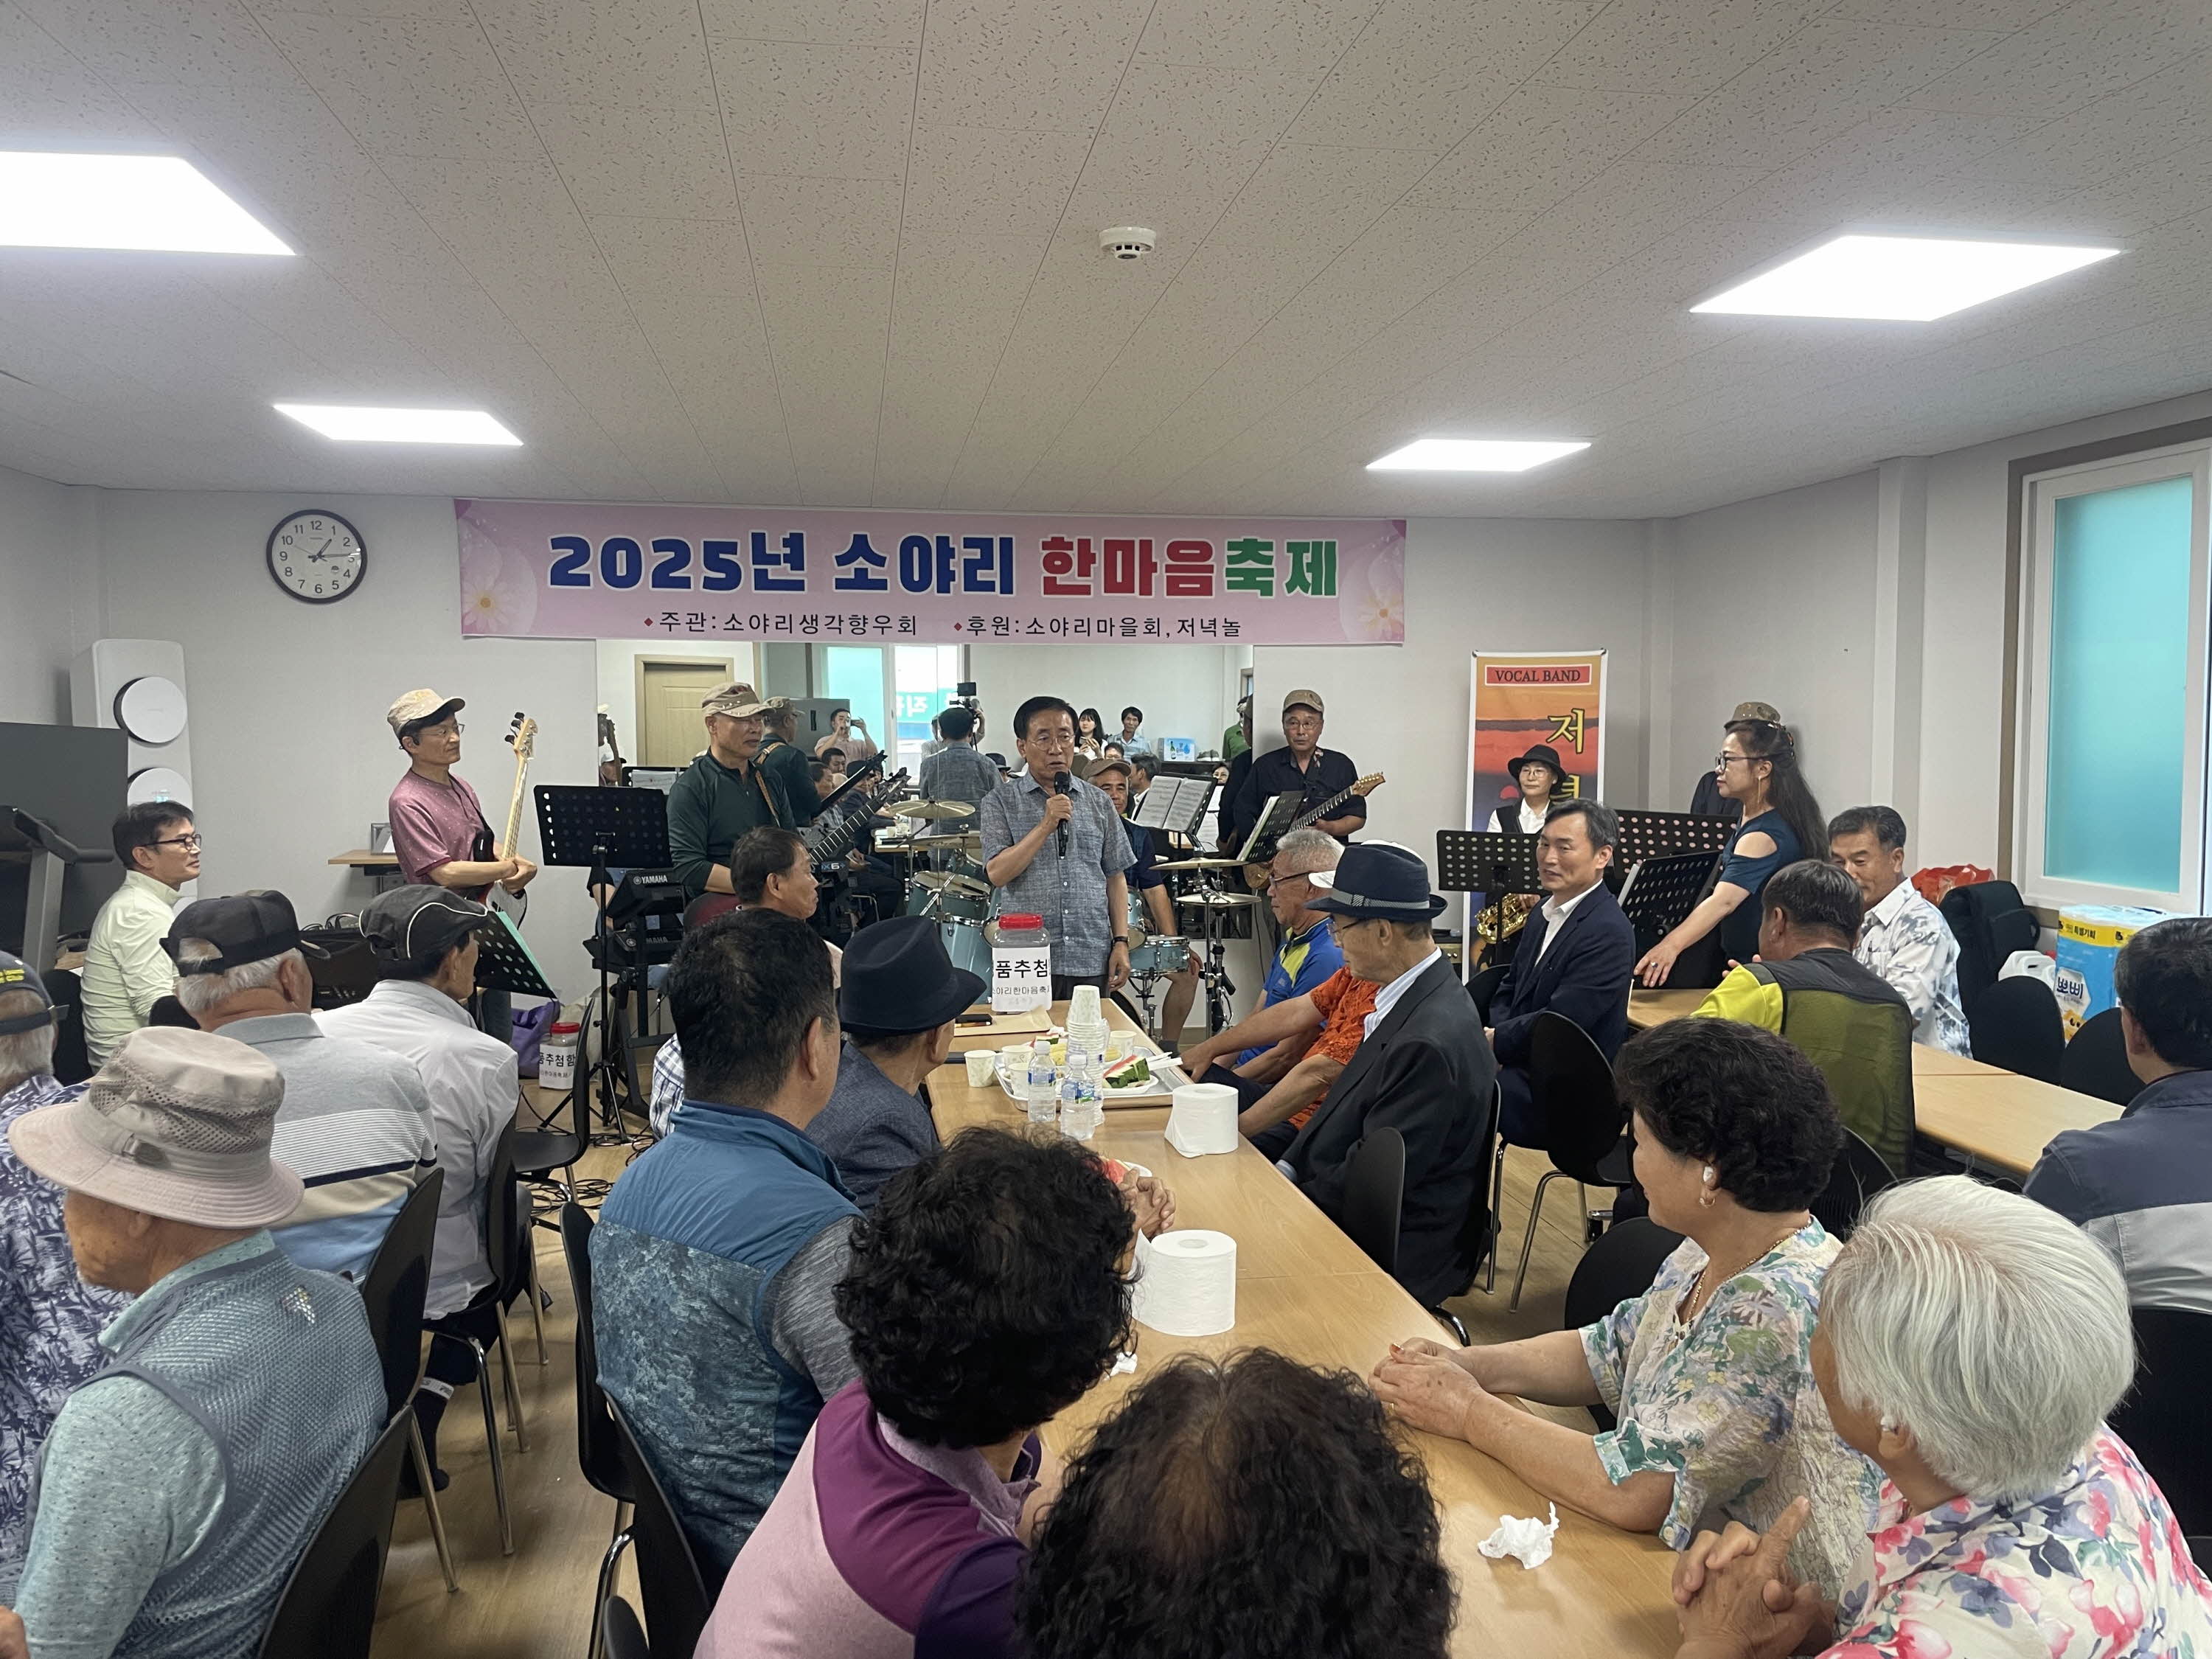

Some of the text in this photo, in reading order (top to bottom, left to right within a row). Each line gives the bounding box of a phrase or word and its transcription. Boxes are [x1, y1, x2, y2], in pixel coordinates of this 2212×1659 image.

[295, 525, 303, 534] 11
[311, 521, 321, 530] 12
[332, 526, 335, 535] 1
[282, 536, 293, 545] 10
[343, 538, 350, 546] 2
[280, 552, 287, 560] 9
[549, 532, 1338, 596] 2025년 소야리 한마음축제
[285, 567, 293, 576] 8
[344, 569, 350, 578] 4
[298, 580, 305, 588] 7
[333, 581, 339, 589] 5
[315, 584, 322, 594] 6
[1495, 670, 1580, 682] VOCAL BAND
[641, 875, 667, 883] YAMAHA
[995, 959, 1051, 978] 품추첨
[2057, 977, 2084, 998] 뽀삐
